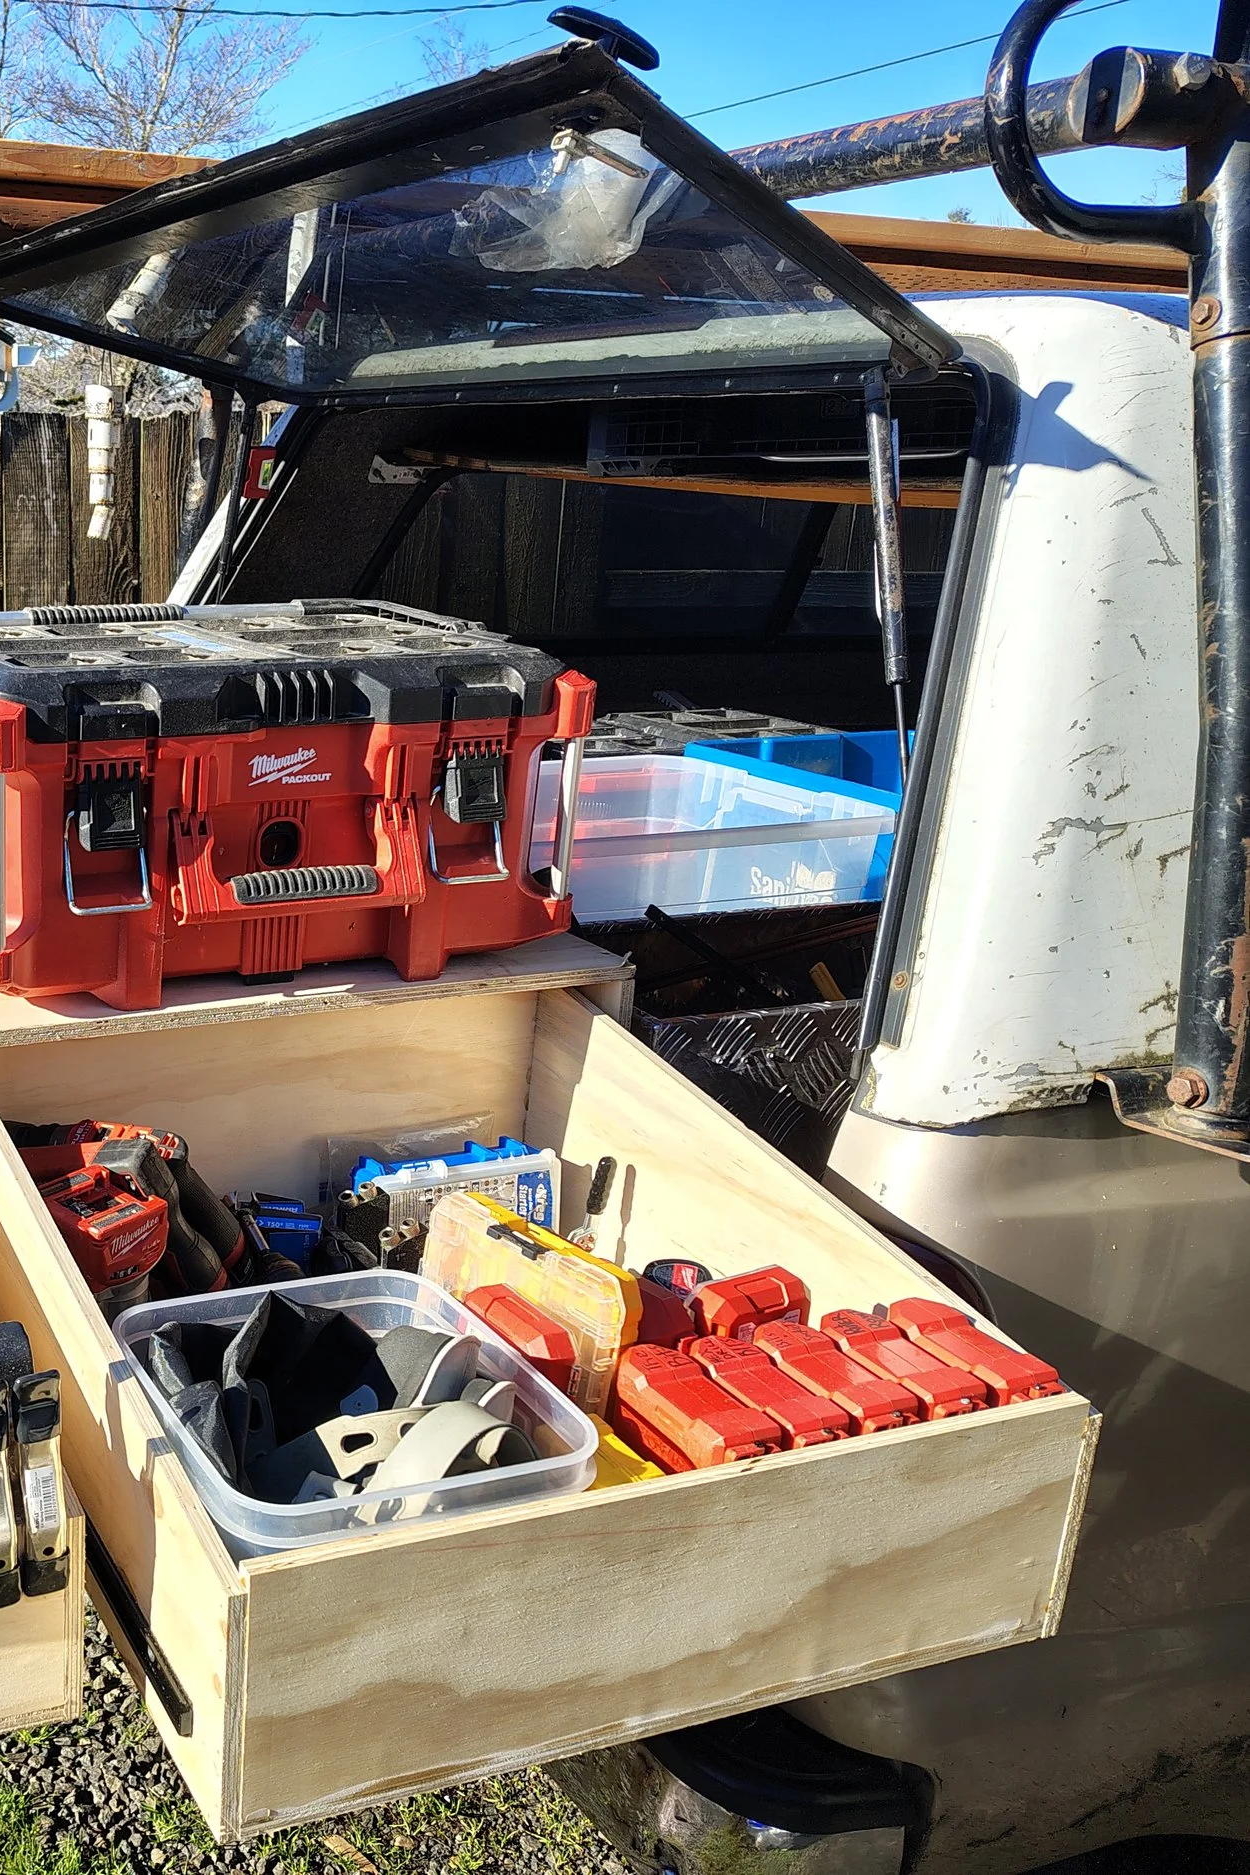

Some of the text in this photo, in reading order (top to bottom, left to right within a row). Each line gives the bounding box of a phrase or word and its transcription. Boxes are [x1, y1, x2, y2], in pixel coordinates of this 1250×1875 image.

[248, 747, 316, 779] Milwaukee
[281, 773, 332, 785] PACKOUT
[110, 1216, 160, 1255] Milwaukee
